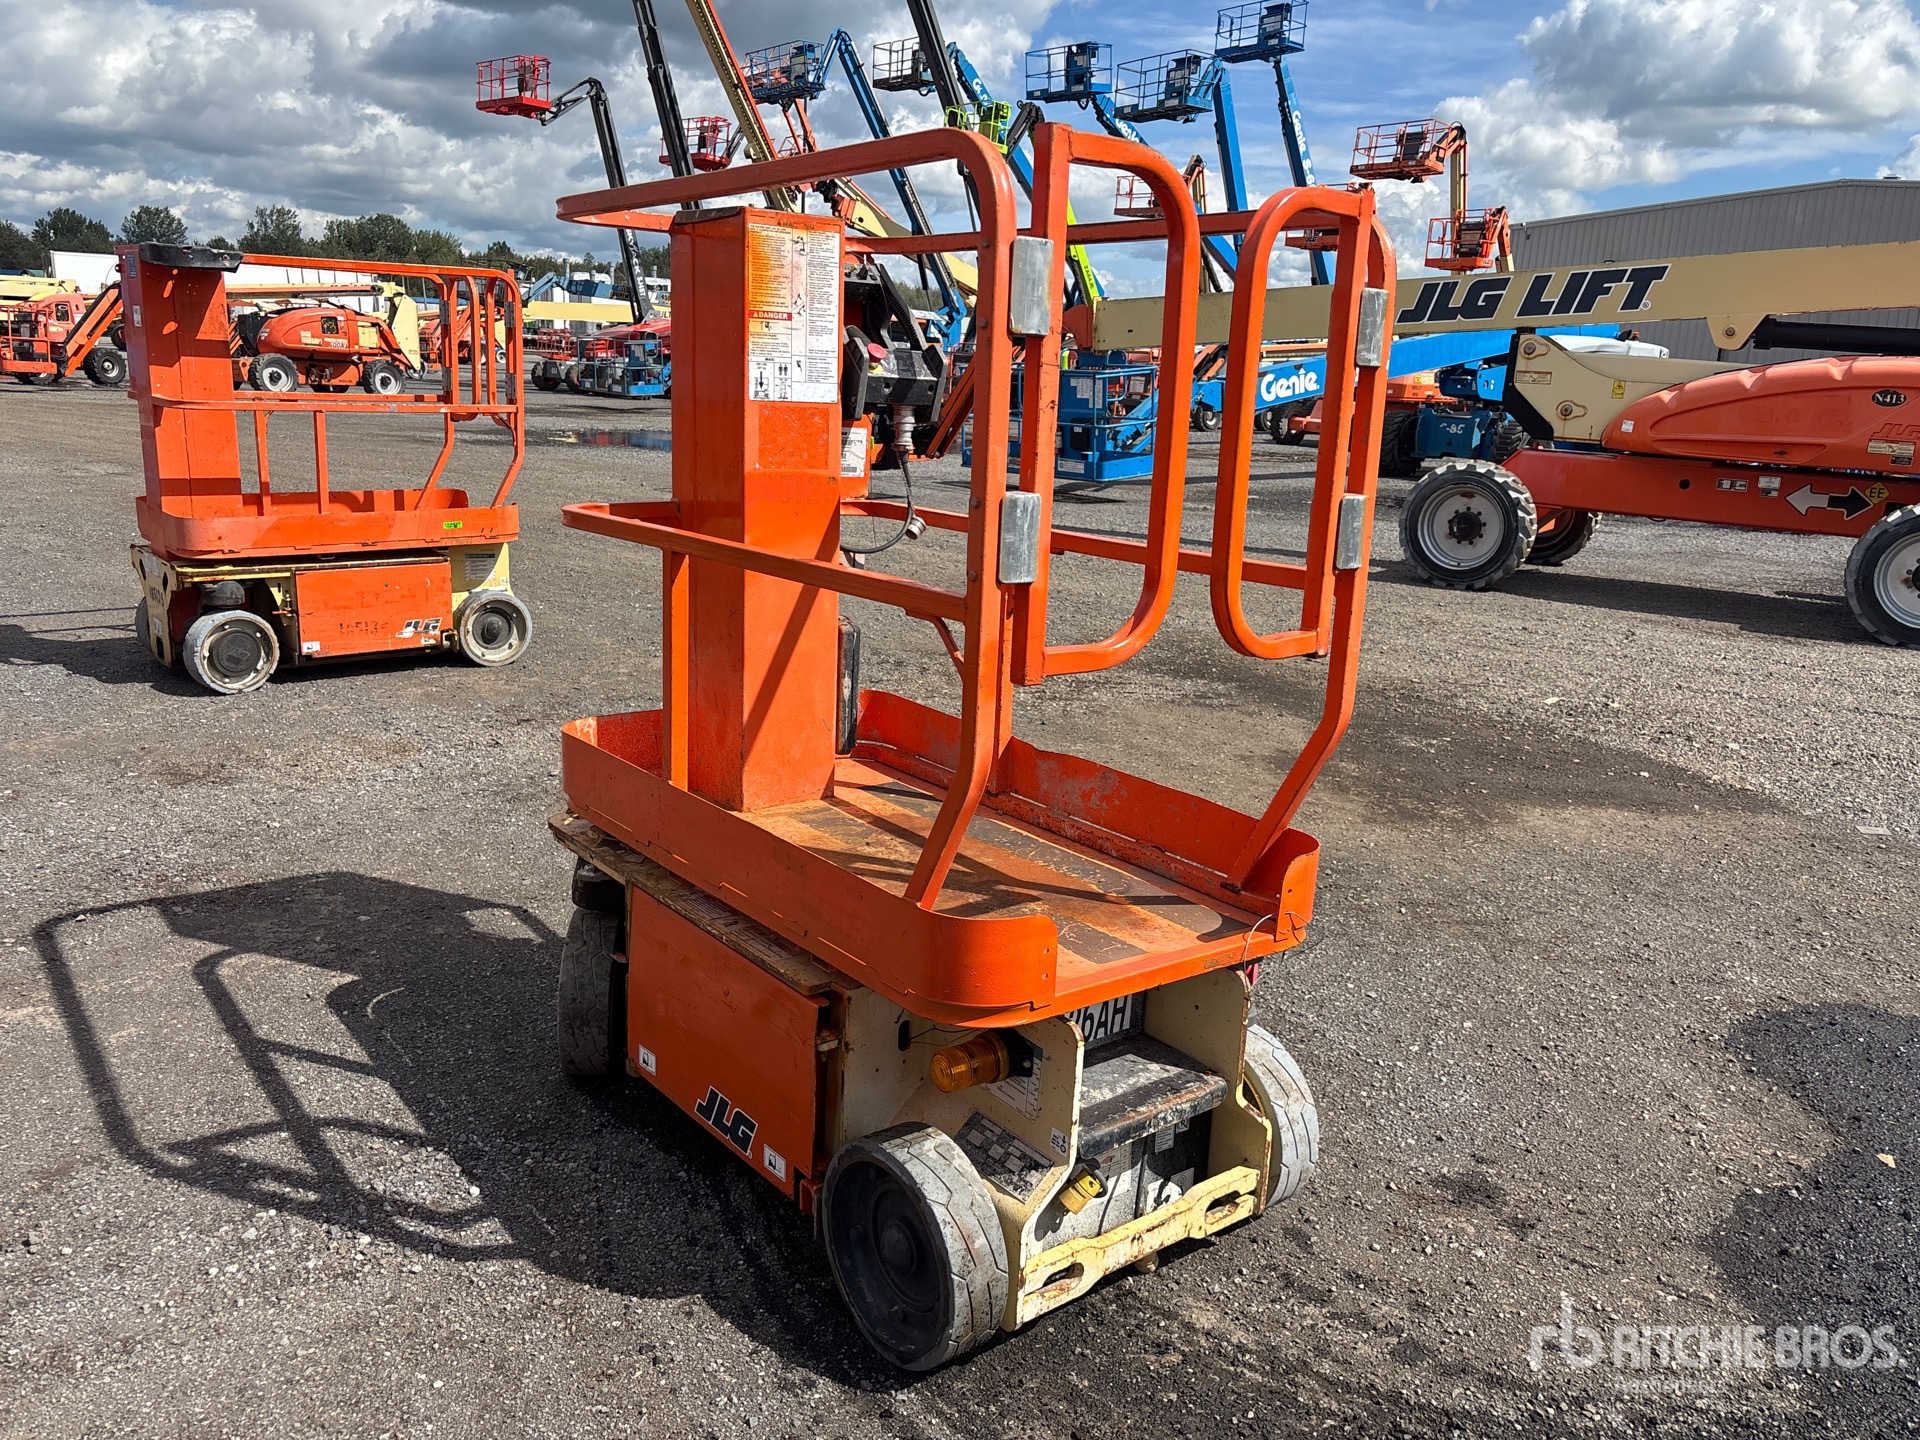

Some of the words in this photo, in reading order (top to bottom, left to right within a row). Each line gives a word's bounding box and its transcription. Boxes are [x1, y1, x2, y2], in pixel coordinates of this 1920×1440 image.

[1292, 110, 1307, 154] Genie
[1303, 159, 1316, 187] S-6
[1395, 276, 1514, 324] JLG
[1514, 263, 1672, 318] LIFT
[1261, 368, 1320, 402] Genie
[1874, 393, 1905, 404] N413
[1868, 487, 1885, 498] EE
[694, 1085, 758, 1156] JLG
